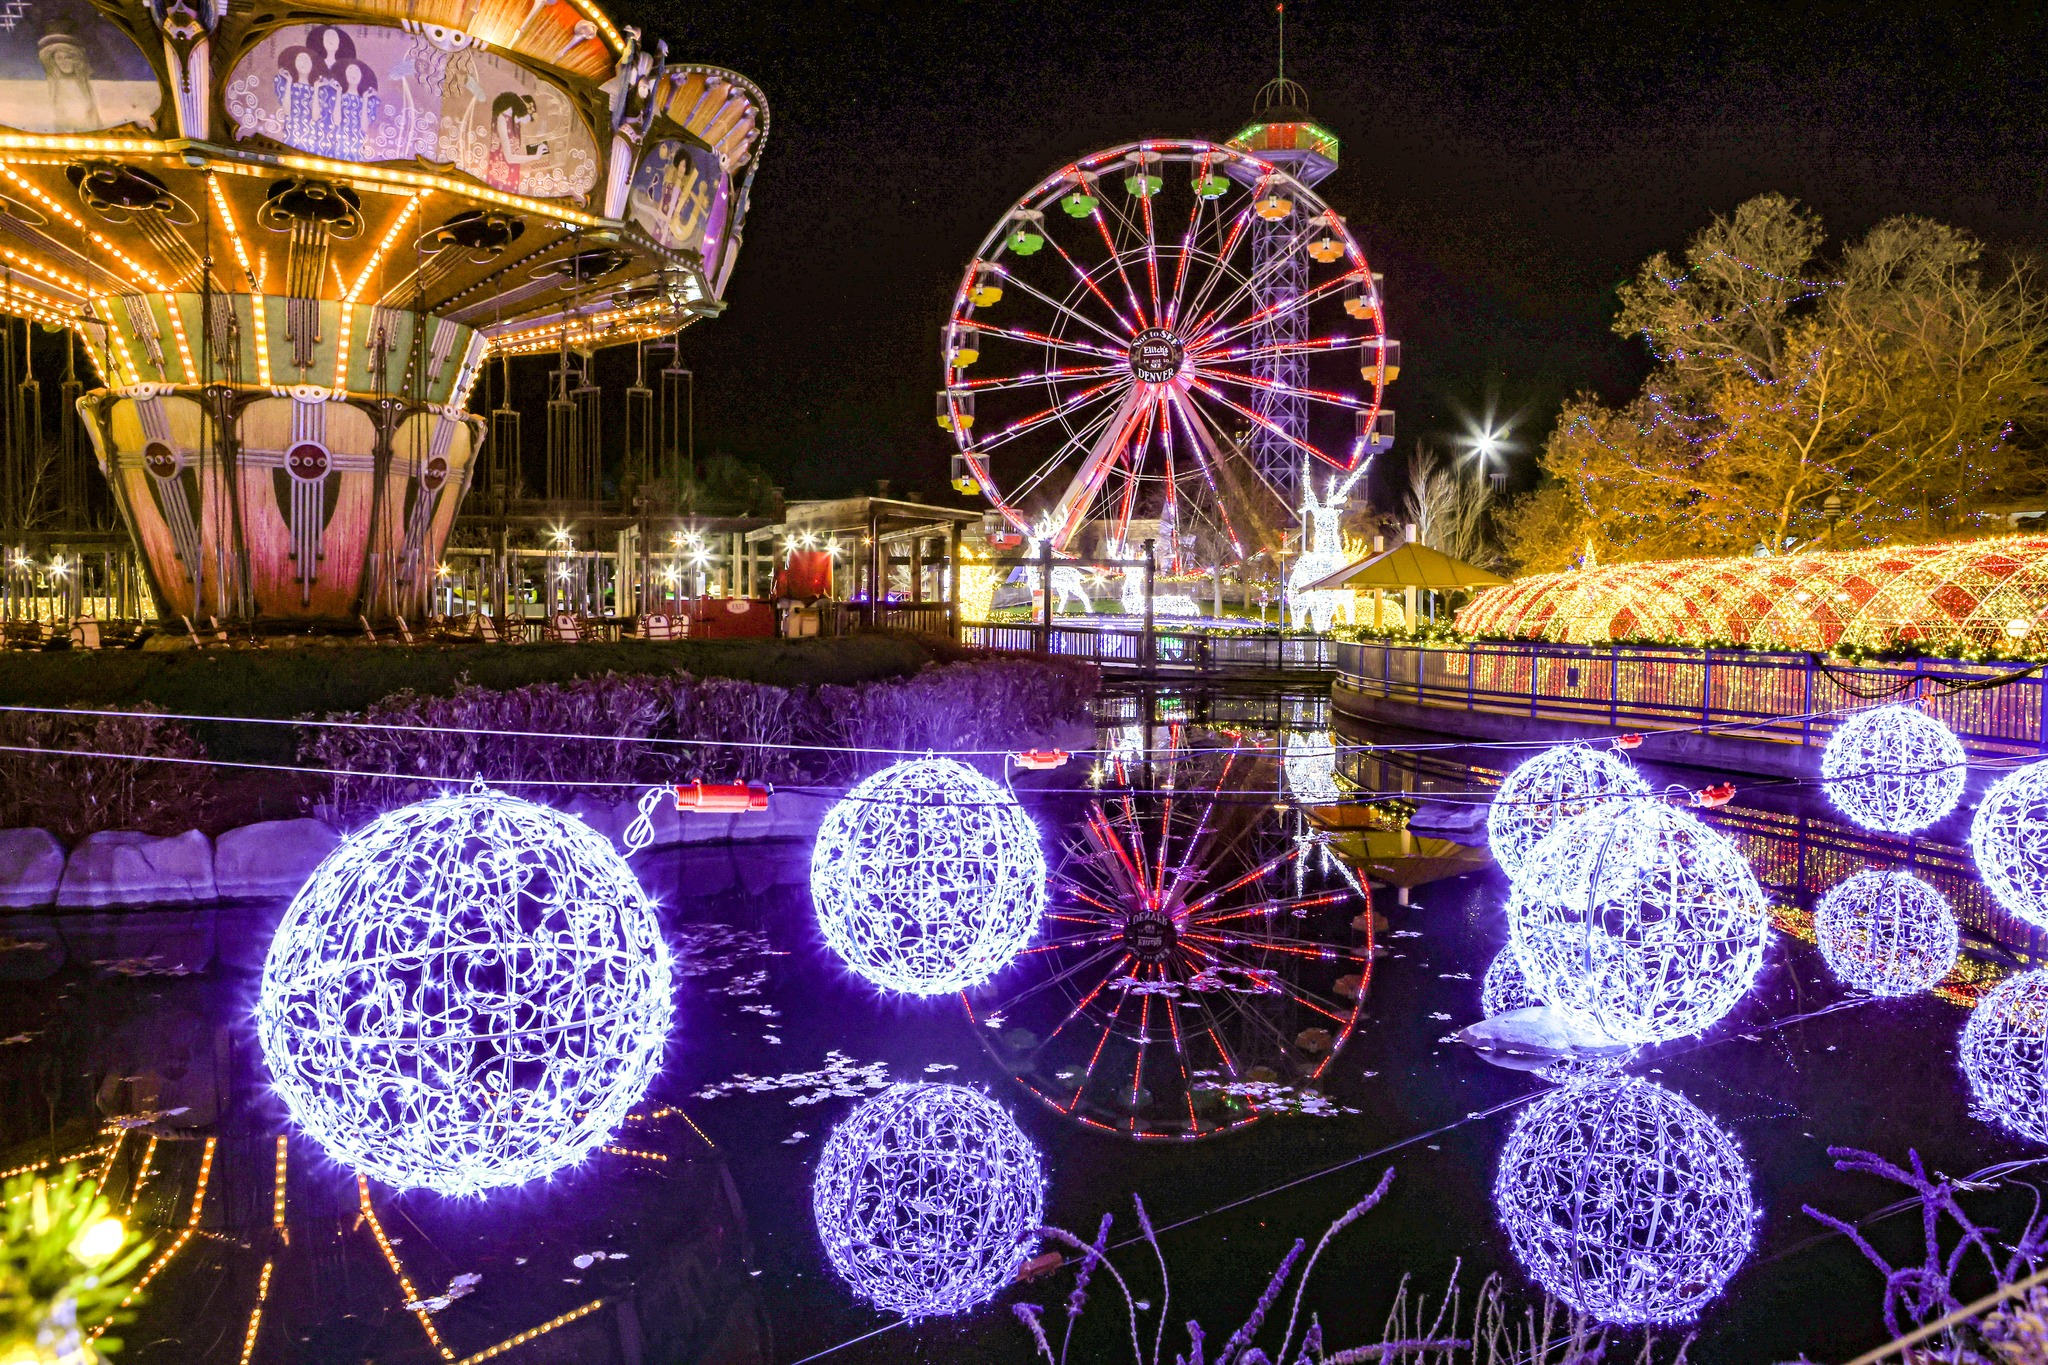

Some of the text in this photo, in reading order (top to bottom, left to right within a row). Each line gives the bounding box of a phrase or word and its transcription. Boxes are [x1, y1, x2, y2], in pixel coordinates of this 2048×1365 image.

[1133, 335, 1148, 348] Not
[1159, 330, 1180, 347] SEE
[1138, 368, 1174, 382] DENVER
